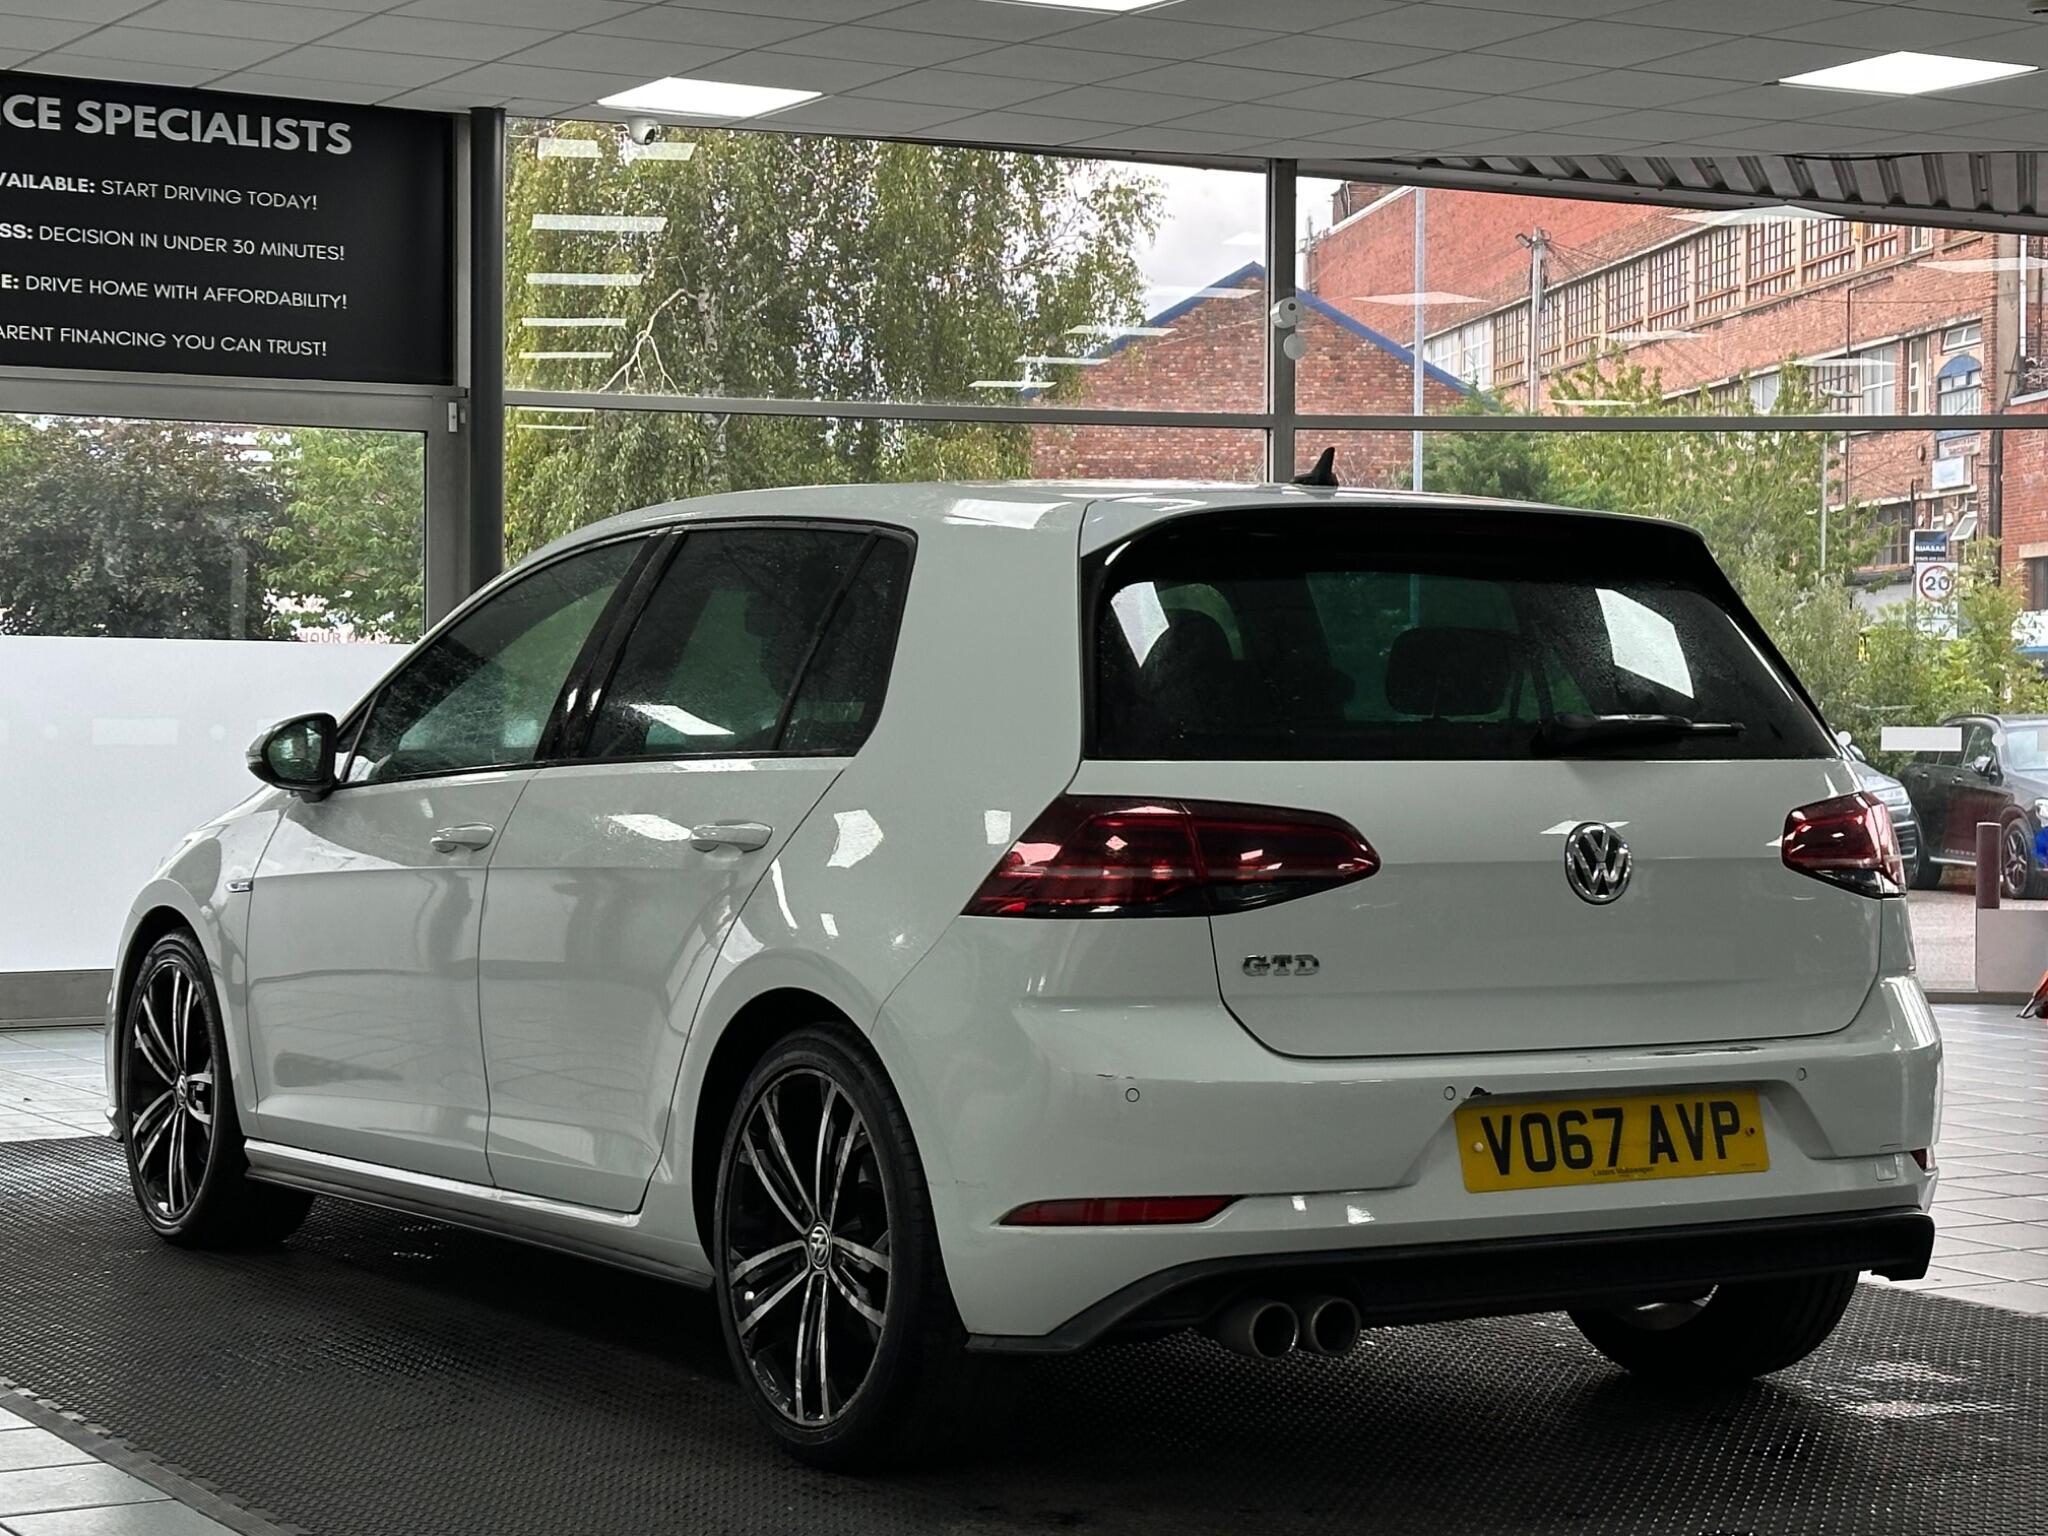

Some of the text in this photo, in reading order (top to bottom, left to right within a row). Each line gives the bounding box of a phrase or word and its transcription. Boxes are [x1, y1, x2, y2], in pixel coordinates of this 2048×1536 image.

[0, 94, 352, 155] CE SPECIALISTS
[102, 180, 159, 198] START
[165, 185, 242, 205] DRIVING
[247, 191, 317, 211] TODAY!
[40, 226, 134, 247] DECISION
[141, 233, 158, 248] IN
[164, 235, 228, 253] UNDER
[233, 240, 255, 255] 30
[261, 242, 345, 261] MINUTES!
[26, 276, 83, 294] DRIVE
[90, 280, 148, 298] HOME
[154, 284, 198, 301] WITH
[203, 287, 347, 310] AFFORDABILITY!
[61, 328, 167, 348] FINANCING
[172, 334, 215, 351] YOU
[221, 337, 262, 353] CAN
[267, 339, 327, 357] TRUST!
[1925, 576, 1951, 591] 20
[1242, 954, 1320, 977] GTD
[1650, 1100, 1741, 1165] AVP
